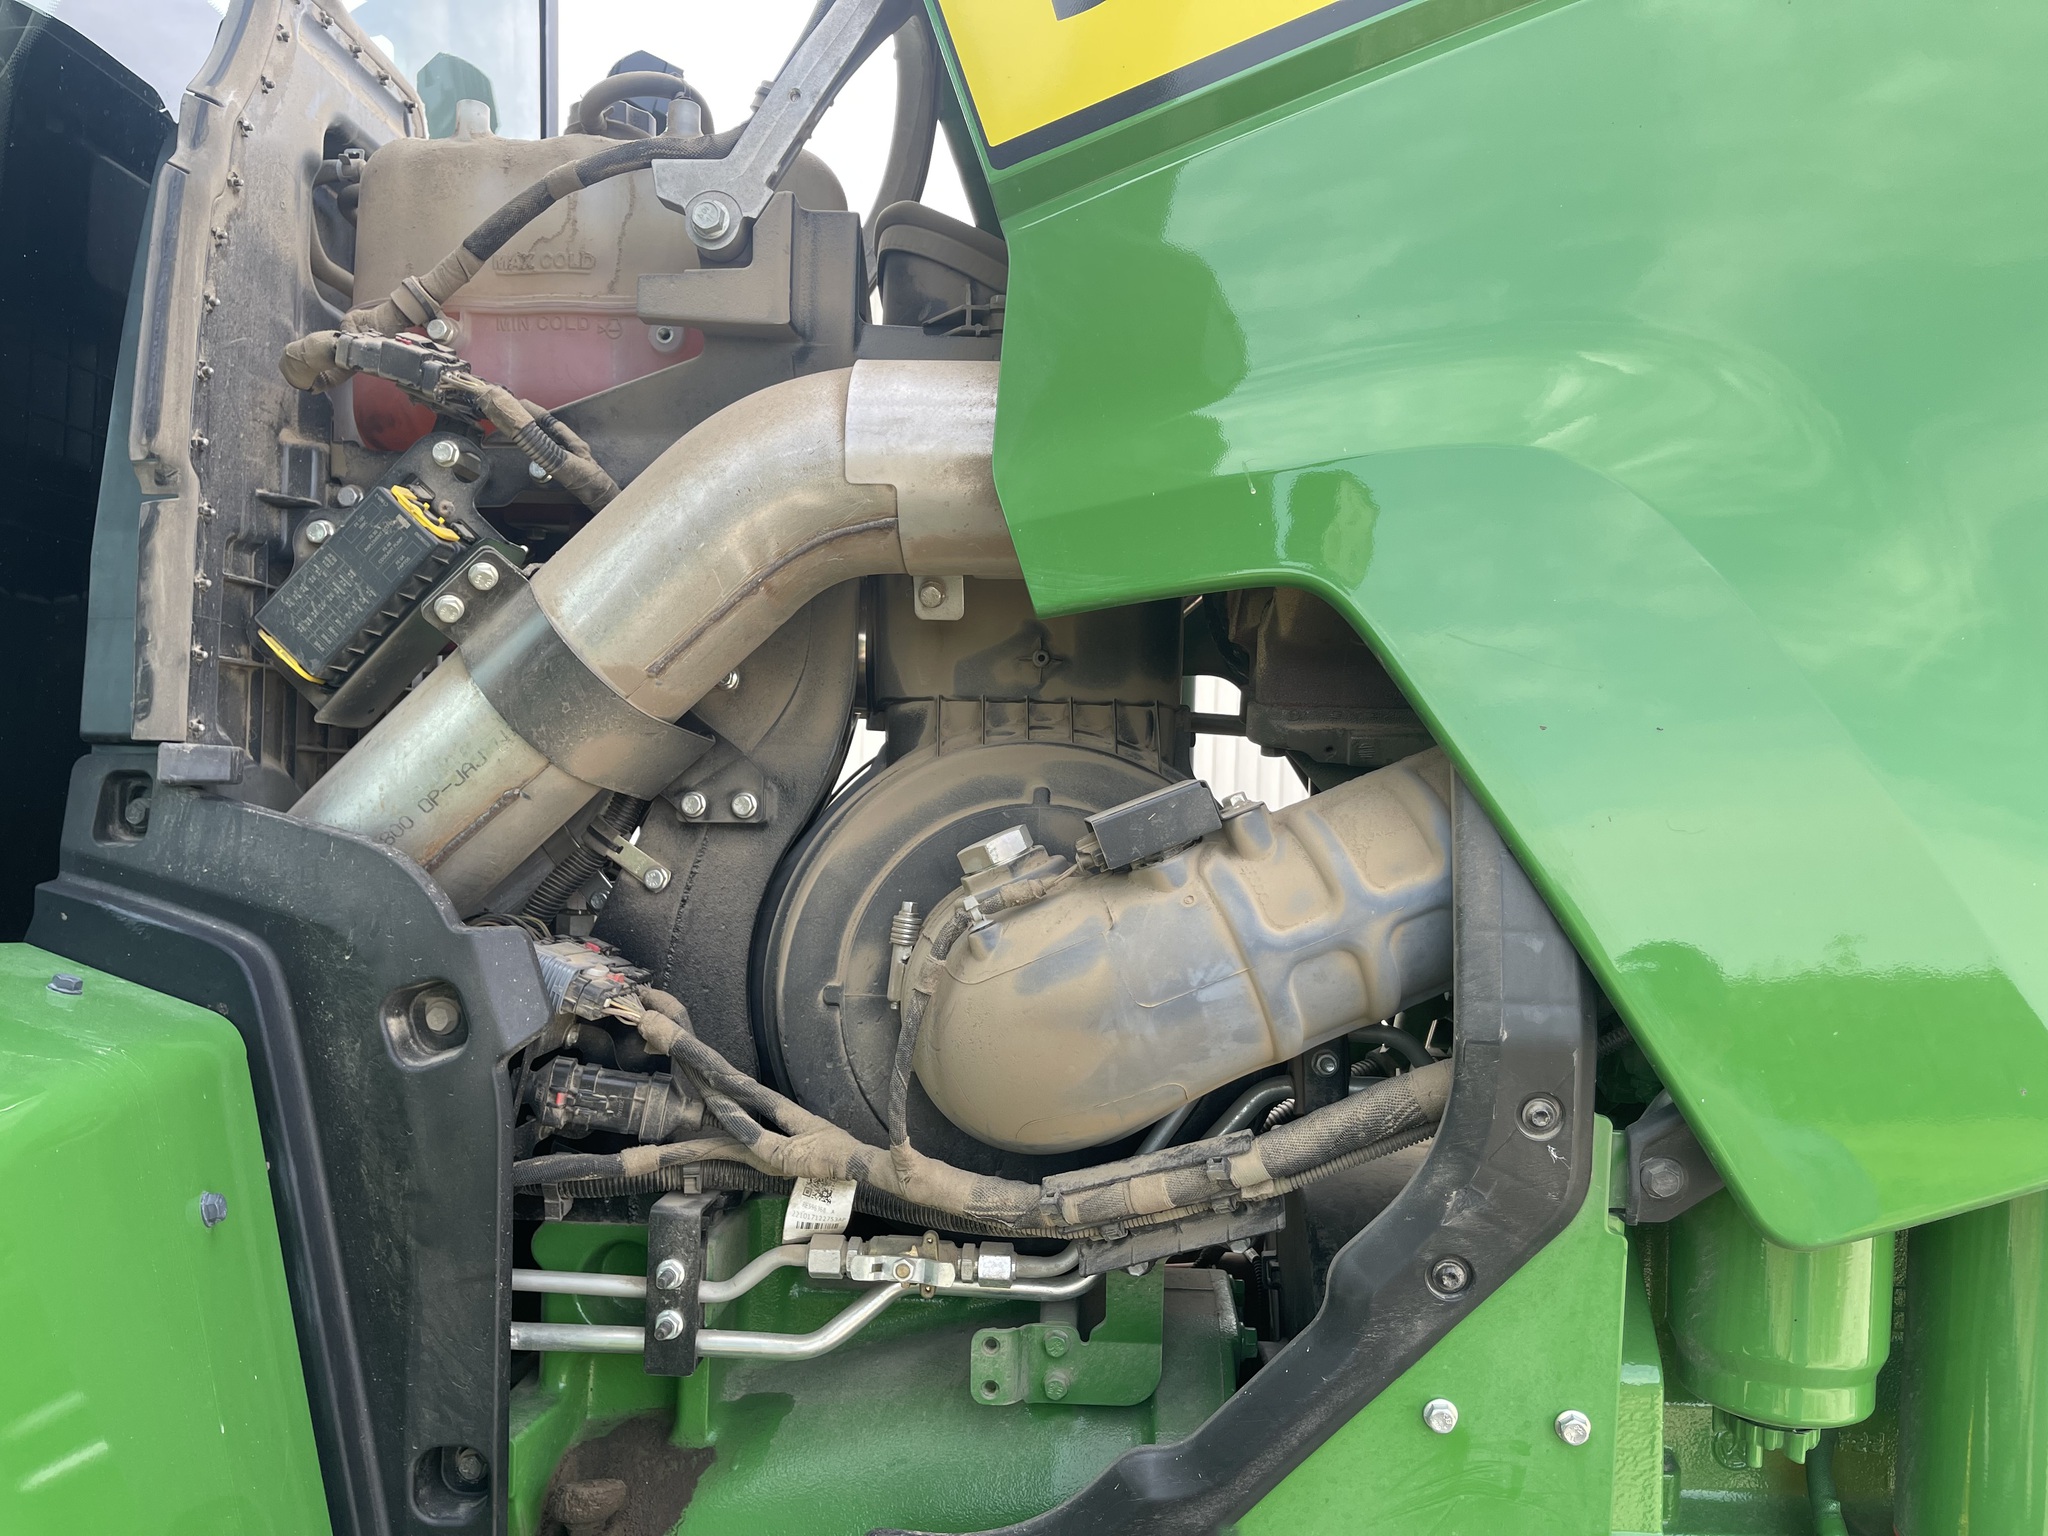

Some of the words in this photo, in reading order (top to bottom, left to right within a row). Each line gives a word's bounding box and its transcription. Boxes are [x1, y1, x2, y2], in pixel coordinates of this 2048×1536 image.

[494, 253, 535, 271] MAX
[540, 250, 596, 270] COLD
[496, 317, 530, 332] MIN
[537, 316, 590, 331] COLD
[380, 816, 414, 846] 800
